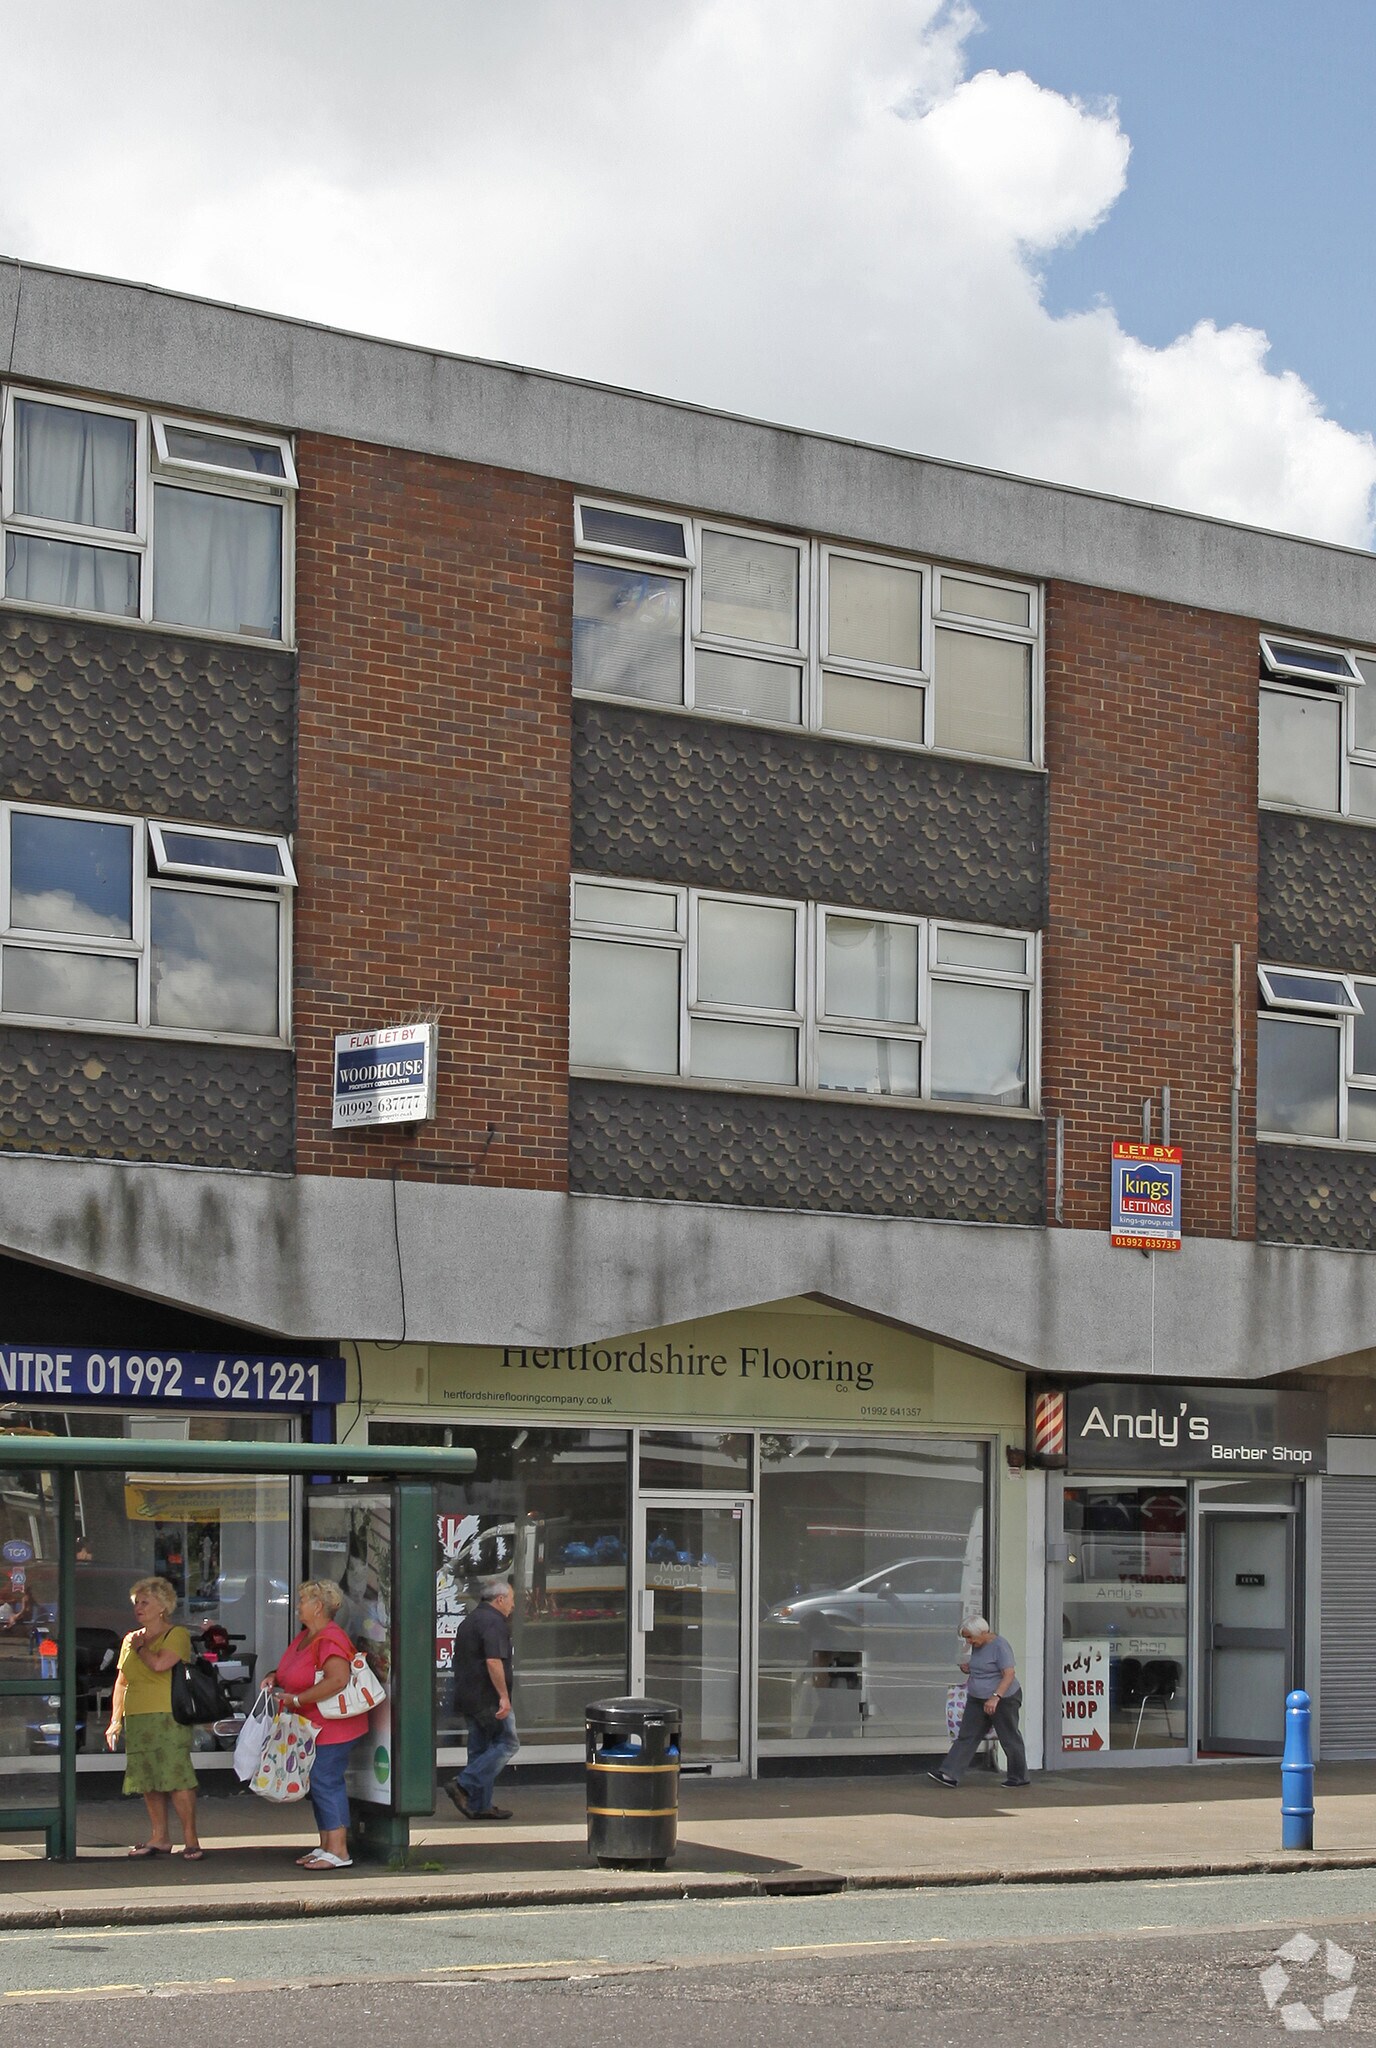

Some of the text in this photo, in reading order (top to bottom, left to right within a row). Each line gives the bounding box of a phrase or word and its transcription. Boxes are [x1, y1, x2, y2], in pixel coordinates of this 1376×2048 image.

[350, 1028, 416, 1048] FLAT LET BY
[339, 1059, 423, 1084] WOODHOUSE
[1119, 1144, 1175, 1158] LET BY
[1125, 1173, 1169, 1201] kings
[1122, 1200, 1171, 1214] LETTINGS
[1119, 1215, 1174, 1227] kings-group.net
[1115, 1237, 1177, 1249] 01992 635735
[500, 1342, 875, 1391] Hertfordshire Flooring
[86, 1353, 183, 1396] 01992
[213, 1359, 320, 1402] 621221
[443, 1389, 613, 1406] hertfordshireflooringcompany.co.uk
[860, 1406, 921, 1416] 01992 641357
[1080, 1402, 1209, 1447] Andy's
[1211, 1445, 1312, 1463] Barber Shop
[1097, 1585, 1142, 1600] Andy's
[1062, 1738, 1090, 1748] PEN
